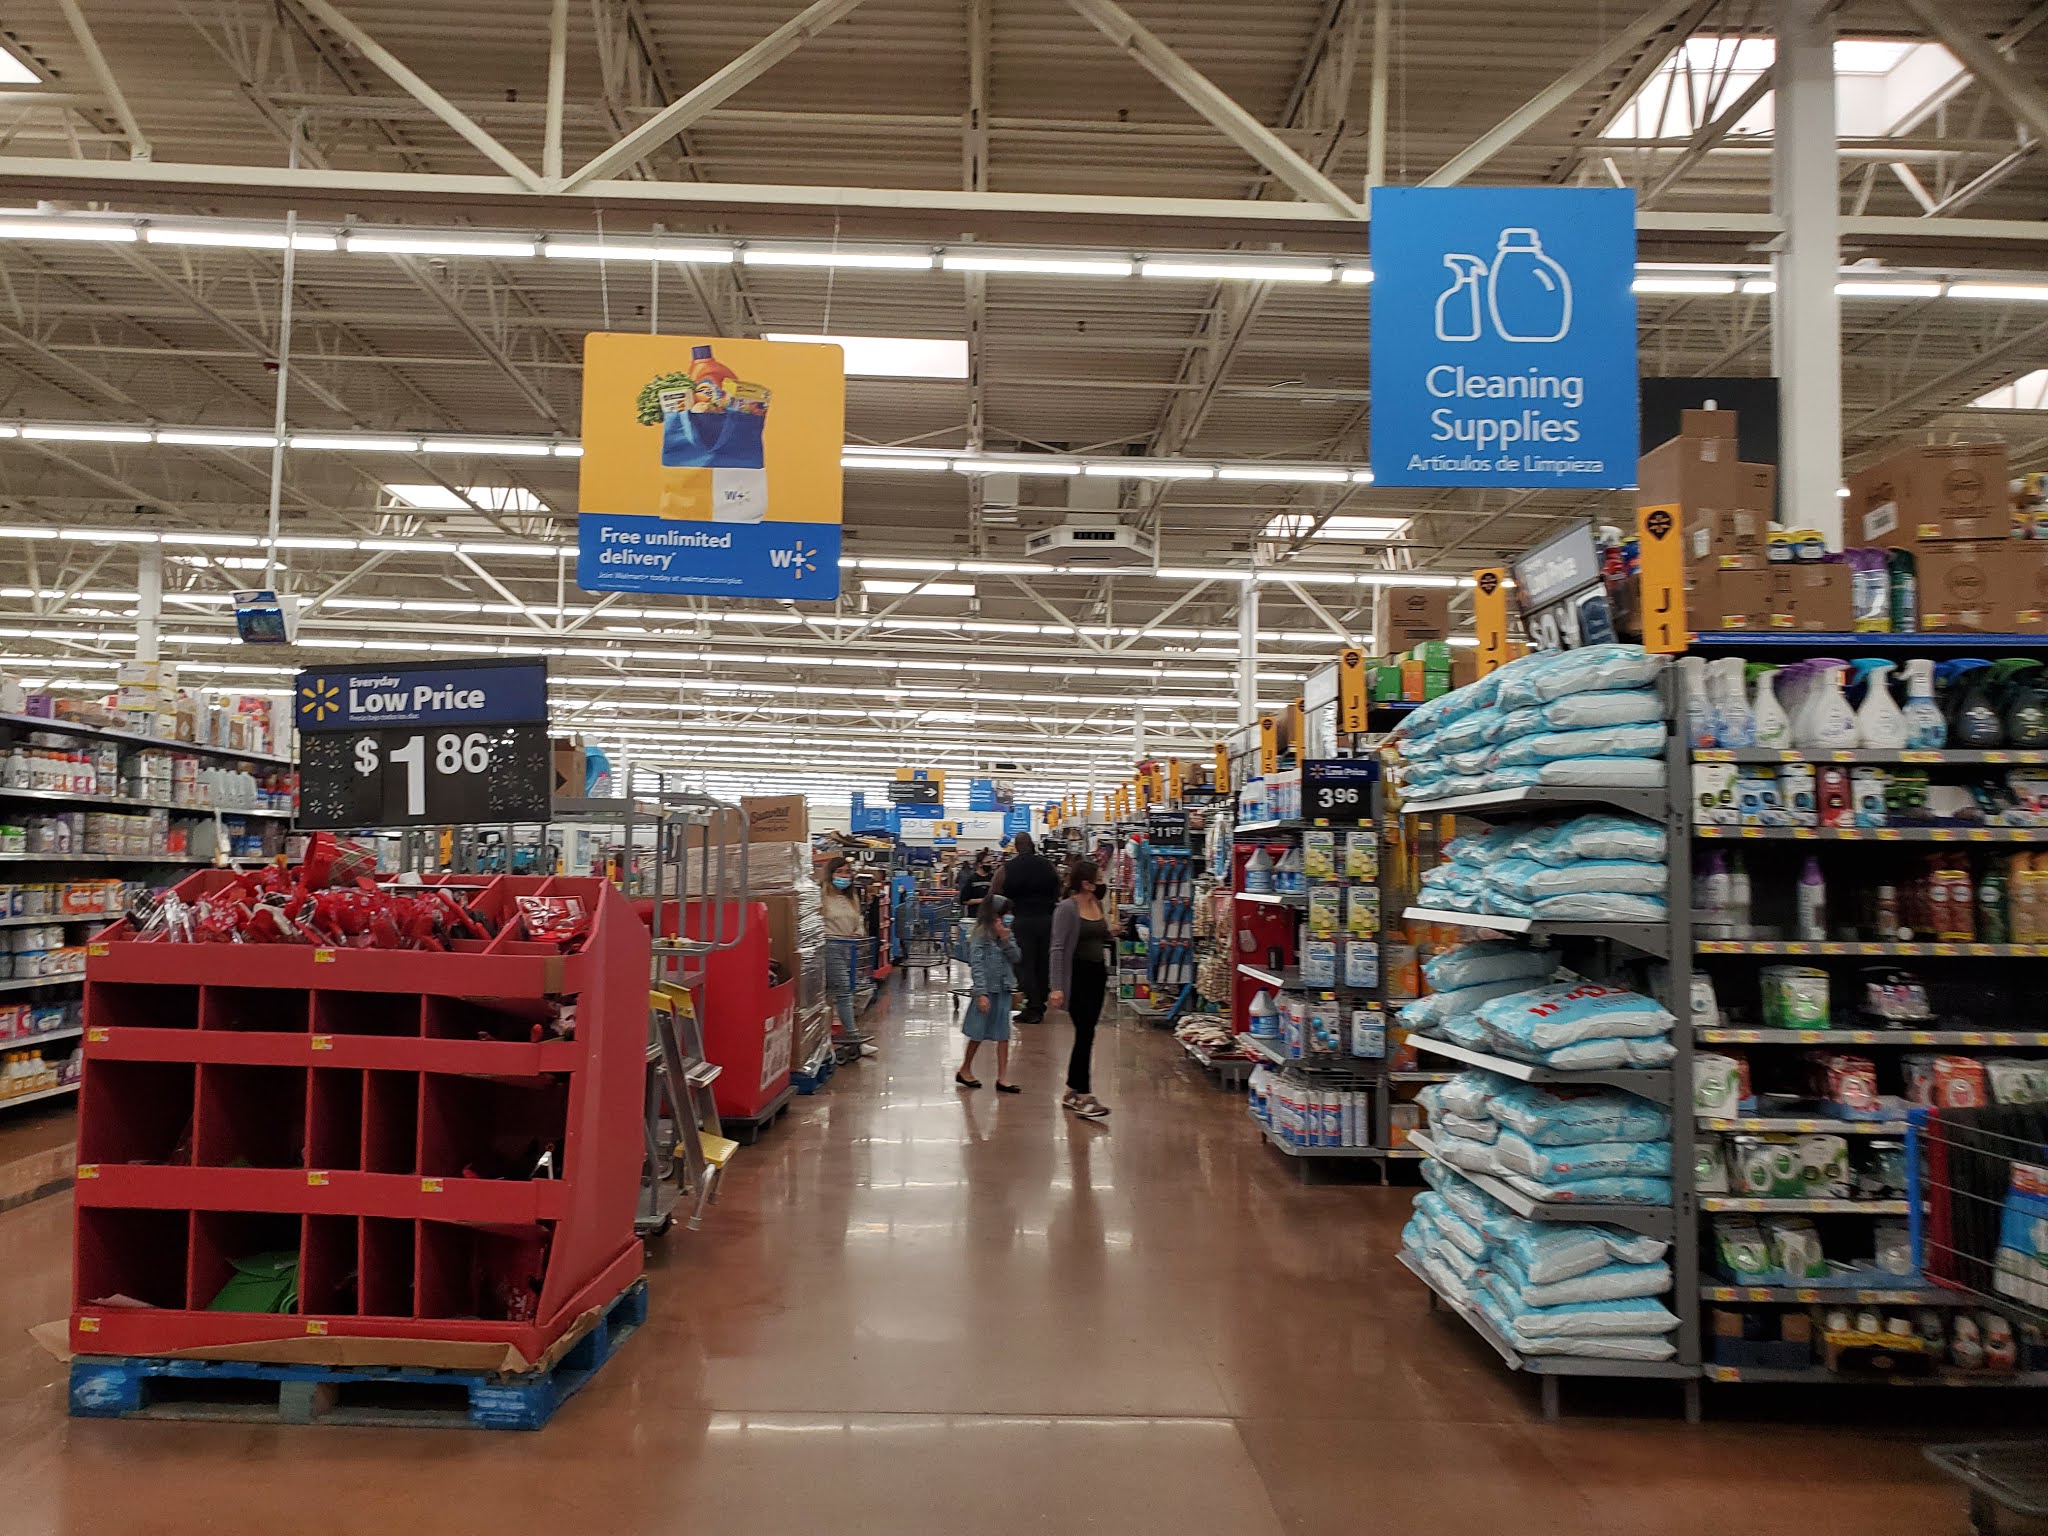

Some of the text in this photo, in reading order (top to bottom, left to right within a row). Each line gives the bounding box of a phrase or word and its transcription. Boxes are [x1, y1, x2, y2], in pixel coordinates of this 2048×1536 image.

[1426, 364, 1583, 408] Cleaning
[1431, 408, 1581, 451] Supplies
[1407, 453, 1604, 476] Artículos de Limpieza
[600, 527, 732, 548] Free unlimited
[349, 676, 400, 689] Everyday
[349, 684, 486, 714] Low Price
